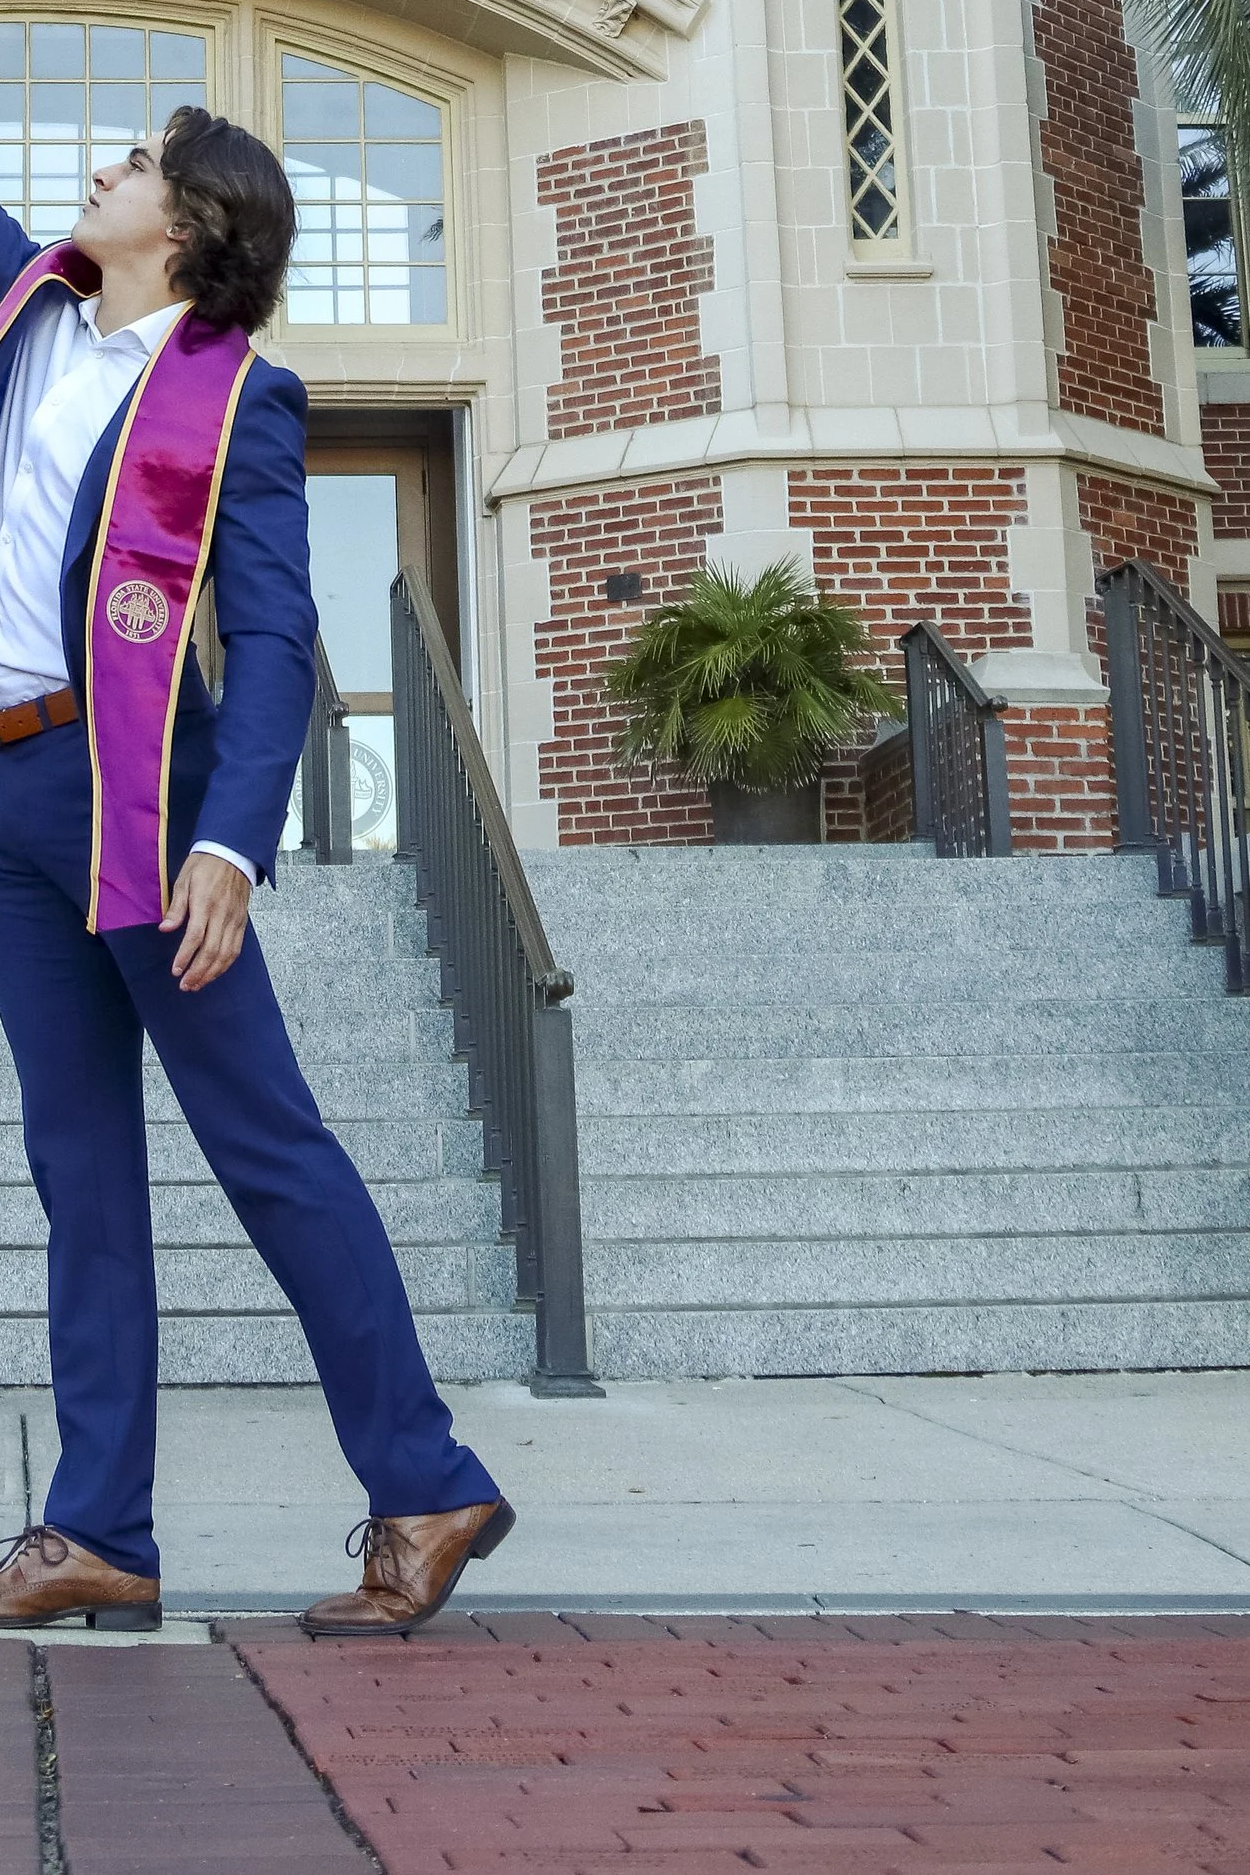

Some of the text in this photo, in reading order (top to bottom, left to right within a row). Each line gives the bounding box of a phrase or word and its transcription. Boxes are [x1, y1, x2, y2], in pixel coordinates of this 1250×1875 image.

[110, 584, 165, 635] FLORIDA STATE UNIVERSITY
[353, 748, 387, 815] UNIVERSITY
